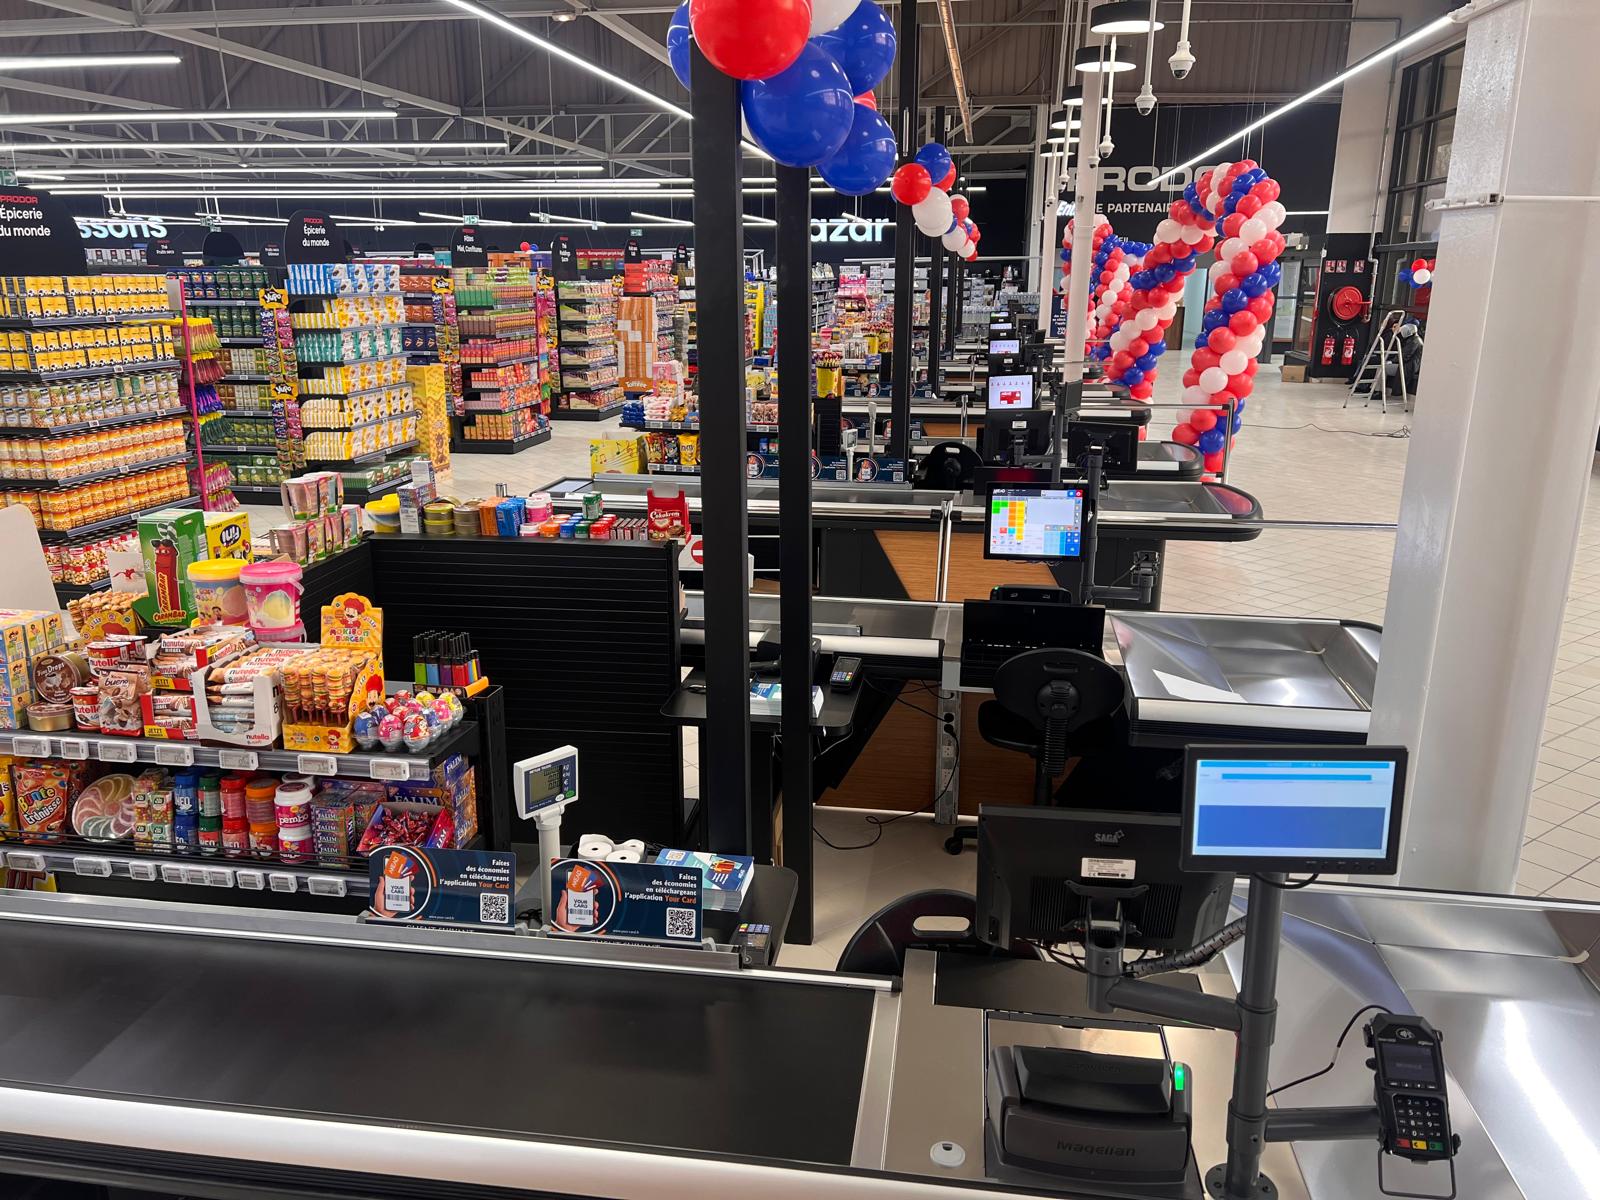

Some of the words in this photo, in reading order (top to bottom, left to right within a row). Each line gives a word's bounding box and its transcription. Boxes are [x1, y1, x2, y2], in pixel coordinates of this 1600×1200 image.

[0, 204, 43, 220] Épicerie
[13, 225, 51, 237] monde
[303, 224, 327, 236] Épicerie
[302, 237, 312, 247] du
[313, 237, 330, 247] monde
[162, 640, 186, 648] hanuta
[104, 678, 129, 687] bueno
[18, 786, 56, 813] Bunte
[23, 797, 62, 825] Erdnüsse
[279, 813, 309, 824] pembo
[1095, 833, 1118, 843] SAGA
[478, 866, 510, 874] économies
[469, 873, 510, 882] téléchargeant
[679, 873, 697, 881] Faites
[440, 879, 477, 888] l'application
[664, 879, 697, 888] économies
[656, 886, 697, 896] téléchargeant
[625, 892, 663, 902] l'application
[665, 894, 680, 903] Your
[1057, 1141, 1136, 1157] Magellan
